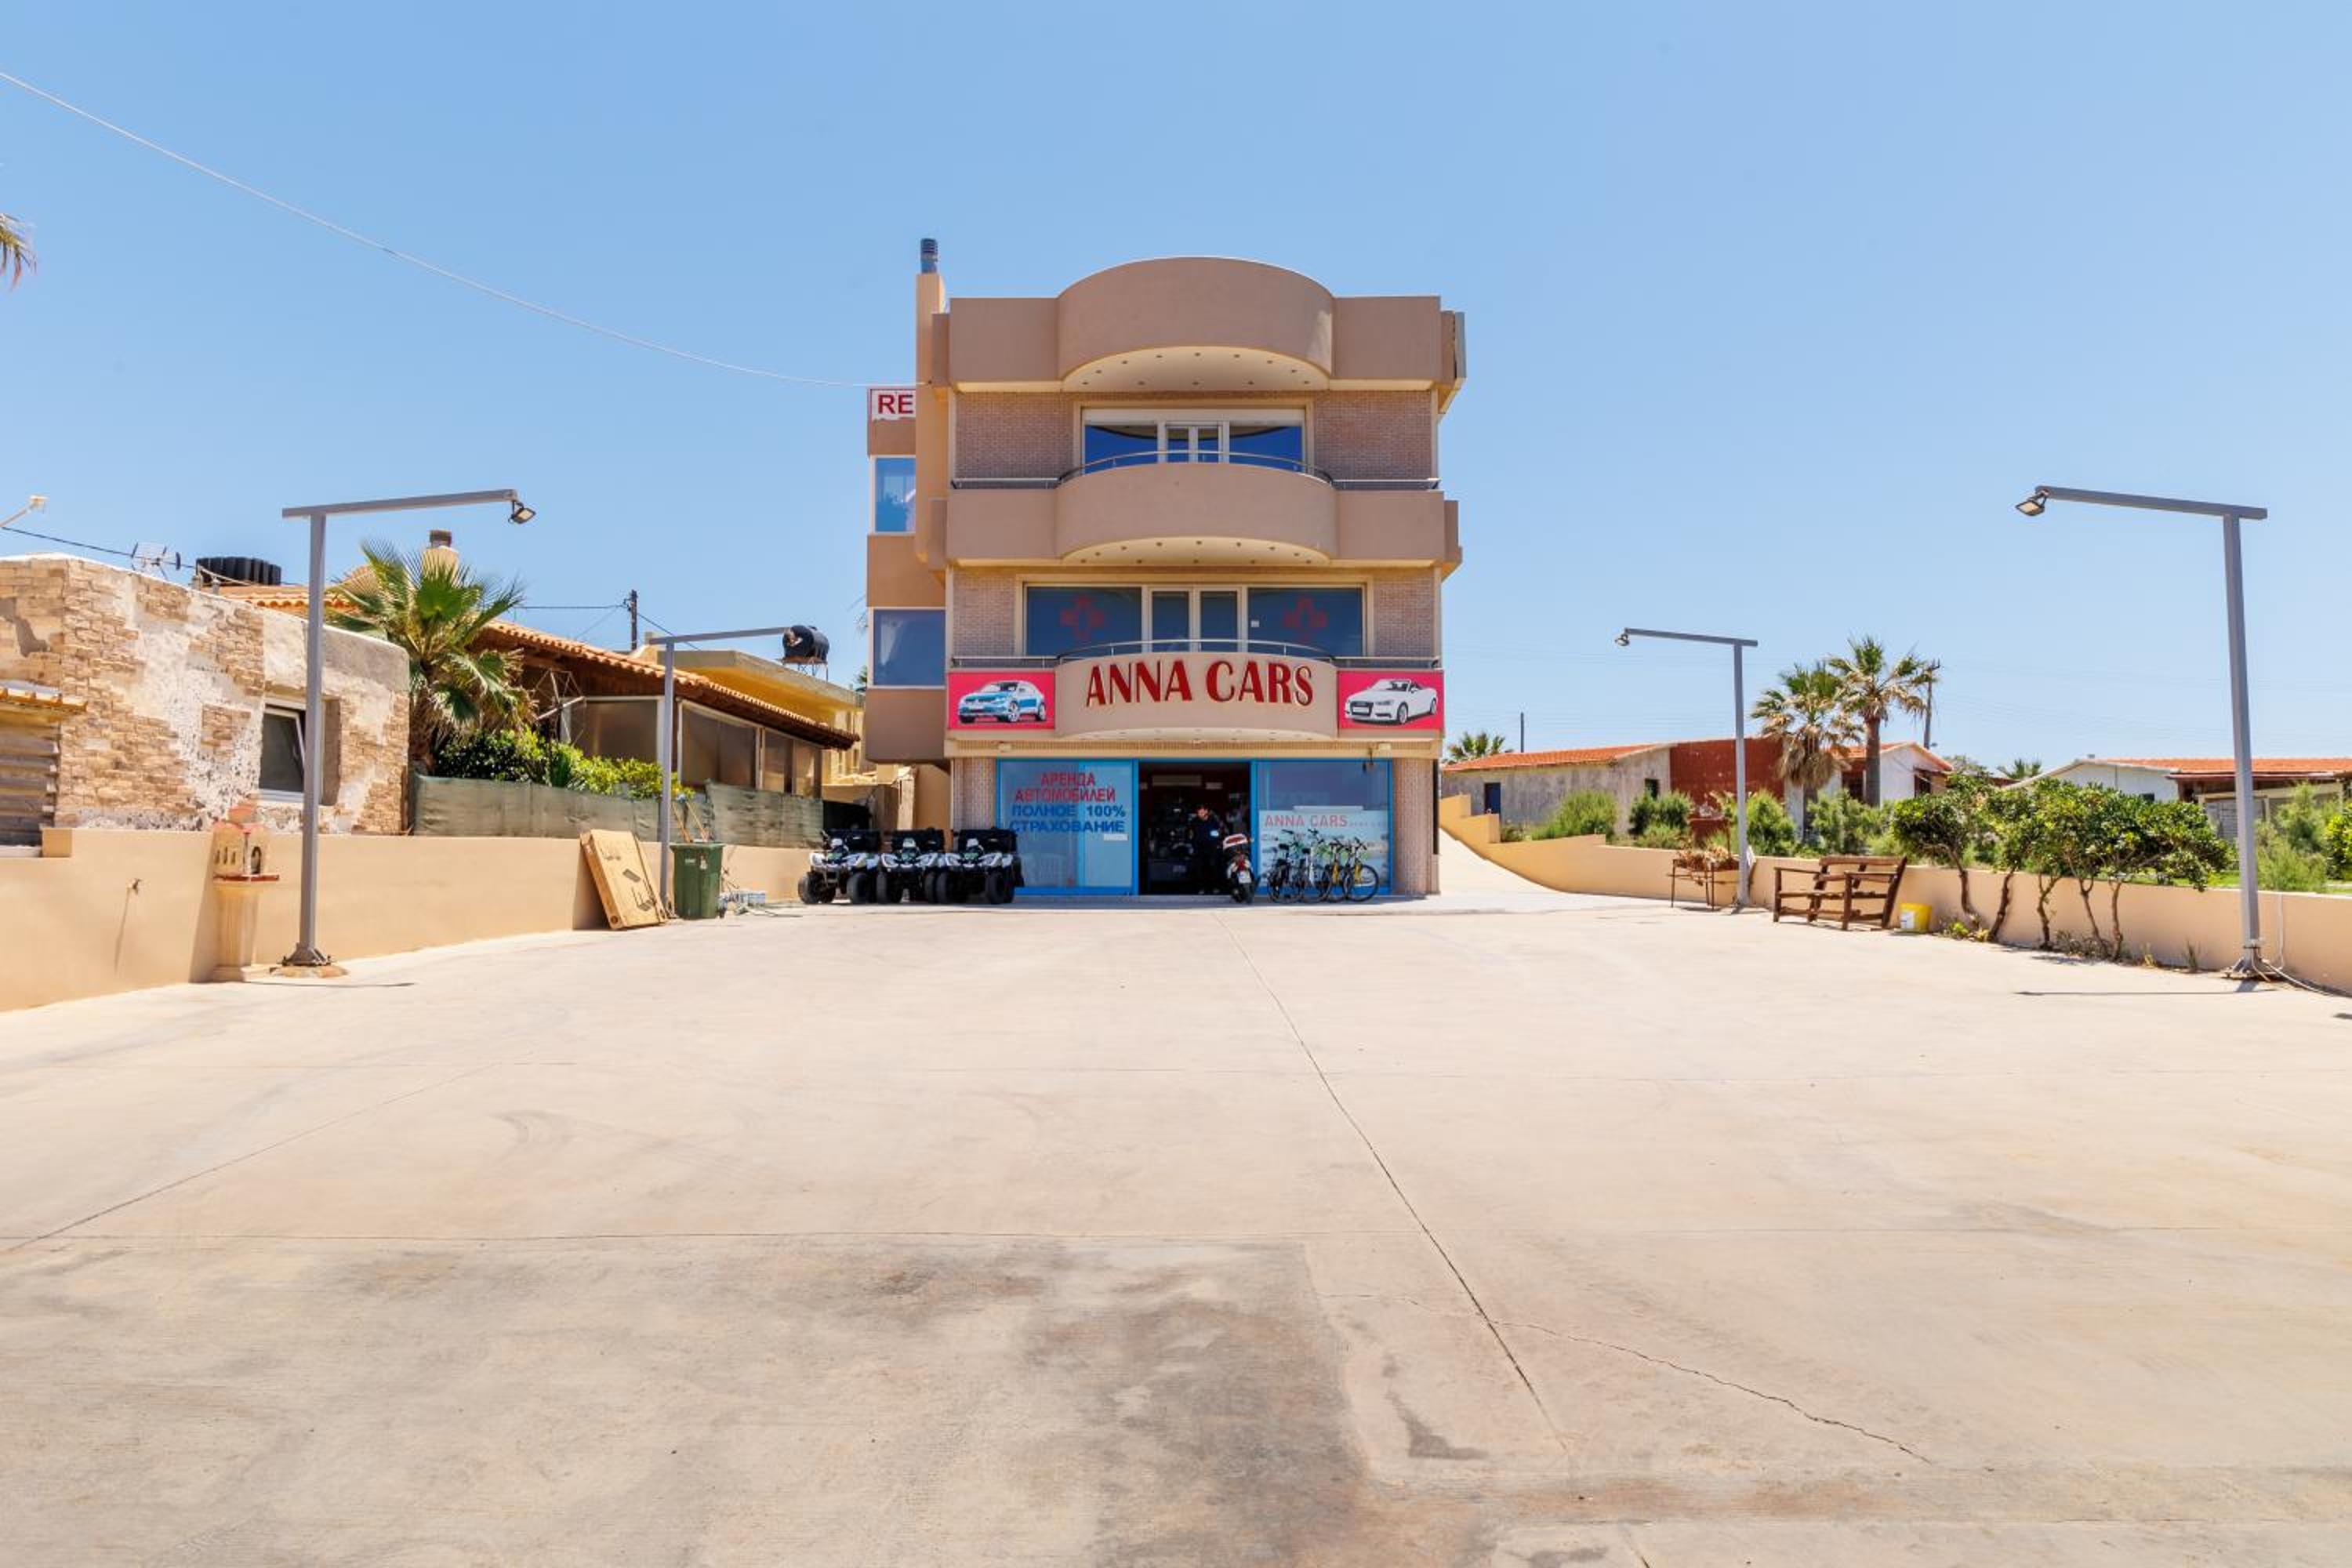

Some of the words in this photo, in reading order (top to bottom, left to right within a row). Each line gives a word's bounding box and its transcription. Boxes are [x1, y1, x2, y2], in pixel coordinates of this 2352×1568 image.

[878, 394, 913, 414] RE
[1087, 660, 1192, 707] ANNA
[1206, 660, 1313, 706] CARS
[1040, 772, 1096, 786] АРЕНДА
[1015, 786, 1116, 803] АВТОМОБИЛЕЙ
[1012, 804, 1077, 816] ПОЛНОЕ
[1087, 804, 1126, 817] 100%
[1010, 820, 1125, 833] СТРАХОВАНИЕ
[1265, 815, 1305, 827] ANNA
[1310, 815, 1348, 827] CARS
